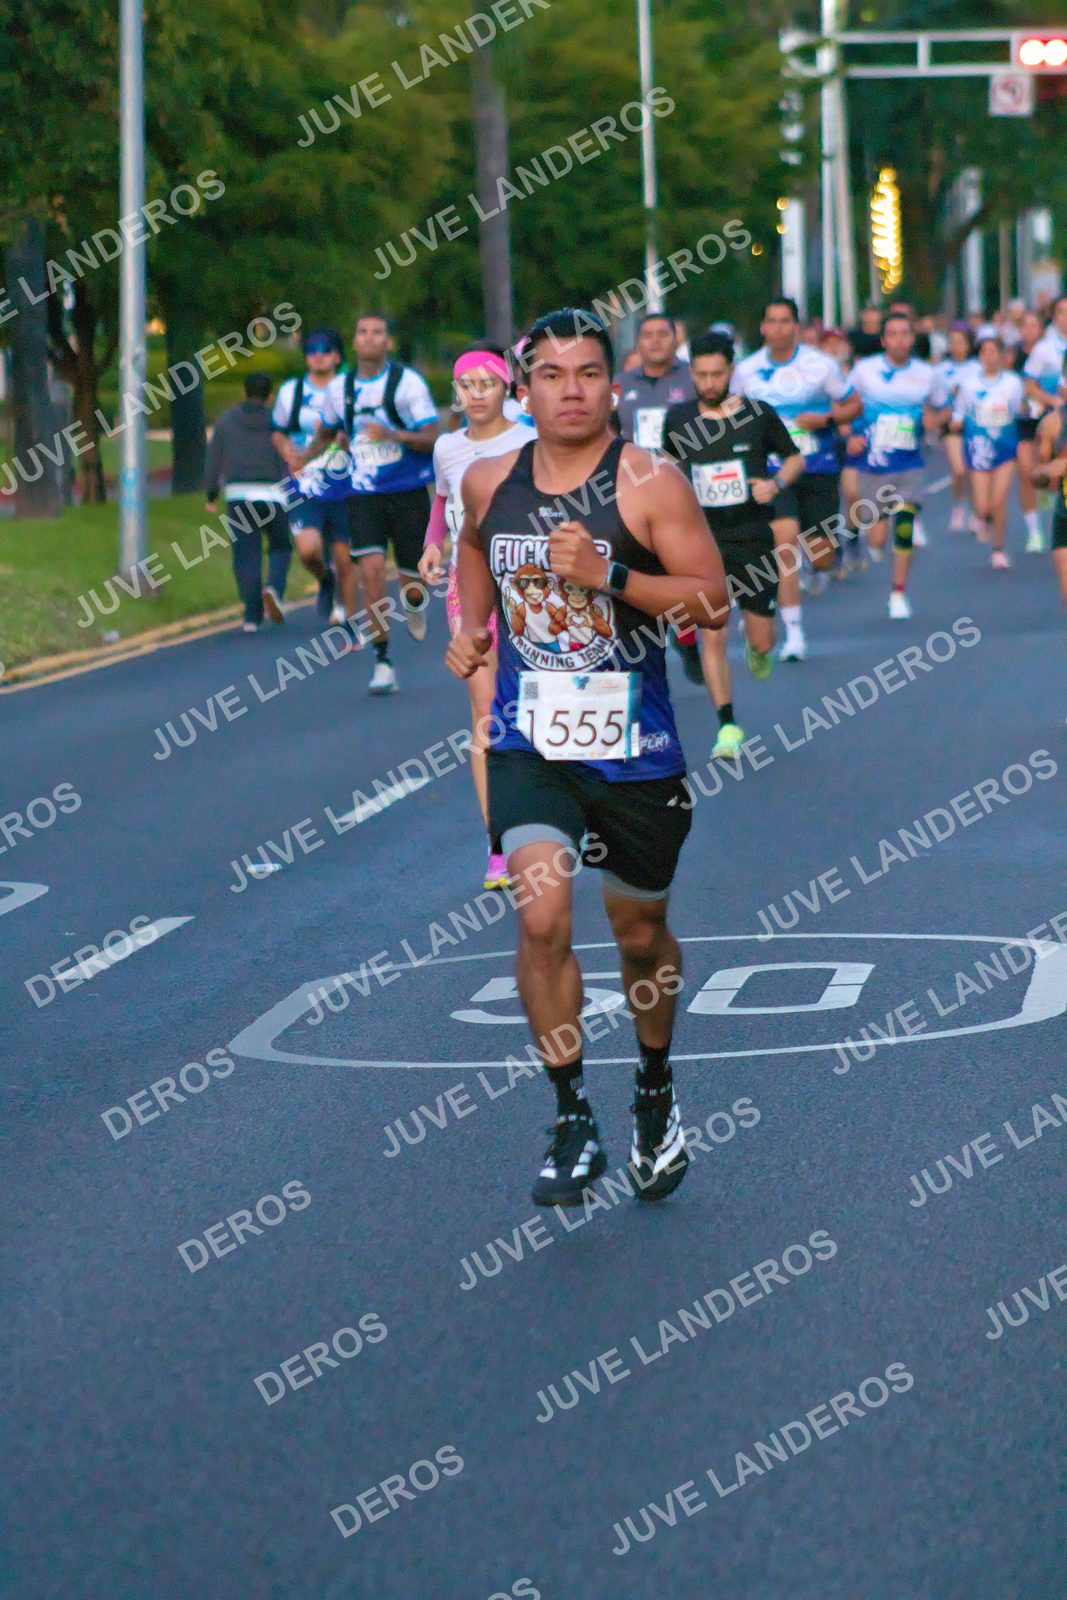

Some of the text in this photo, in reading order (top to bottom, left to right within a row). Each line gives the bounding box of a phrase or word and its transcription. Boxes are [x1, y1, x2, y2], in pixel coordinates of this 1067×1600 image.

[695, 480, 744, 501] 1698
[515, 638, 612, 669] RUNNING TEAM
[526, 709, 624, 748] 1555
